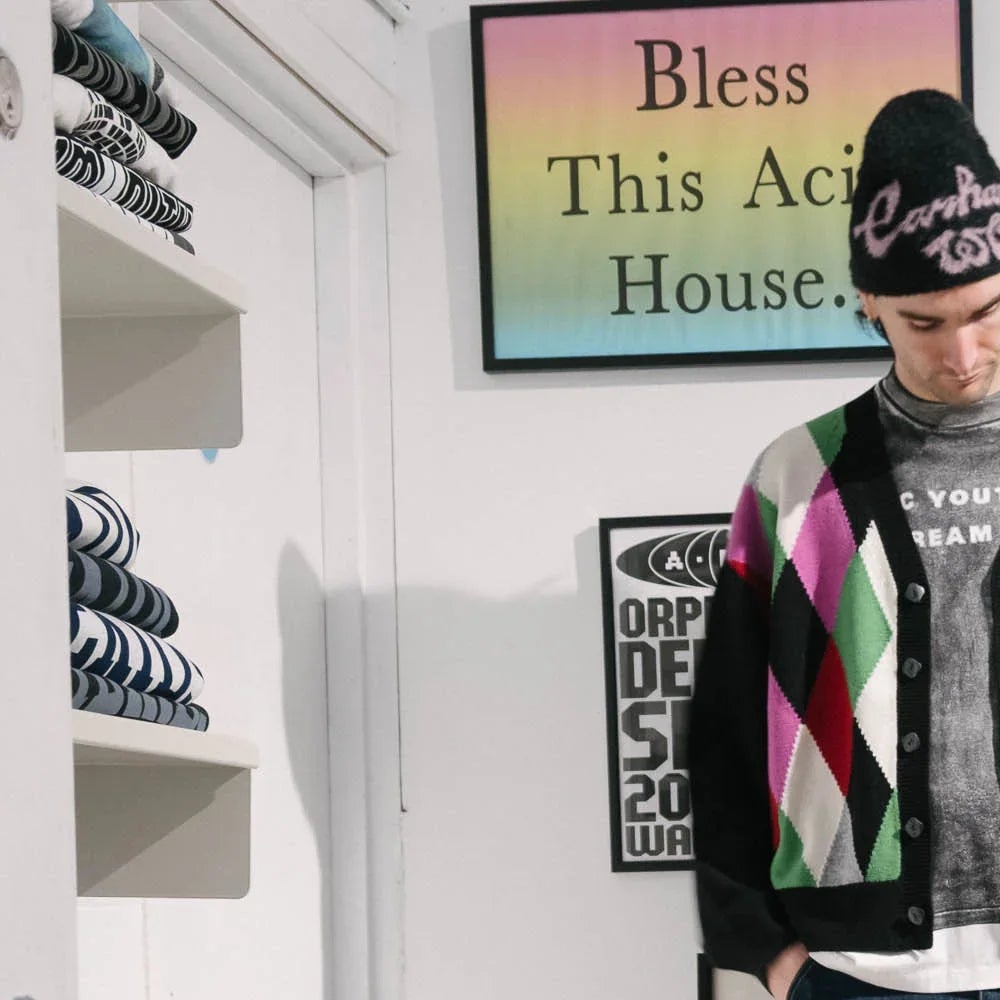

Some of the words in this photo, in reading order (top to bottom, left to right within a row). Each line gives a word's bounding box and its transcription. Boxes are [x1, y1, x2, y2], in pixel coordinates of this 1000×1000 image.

[634, 39, 810, 112] Bless
[547, 151, 704, 216] This
[608, 253, 846, 315] House.
